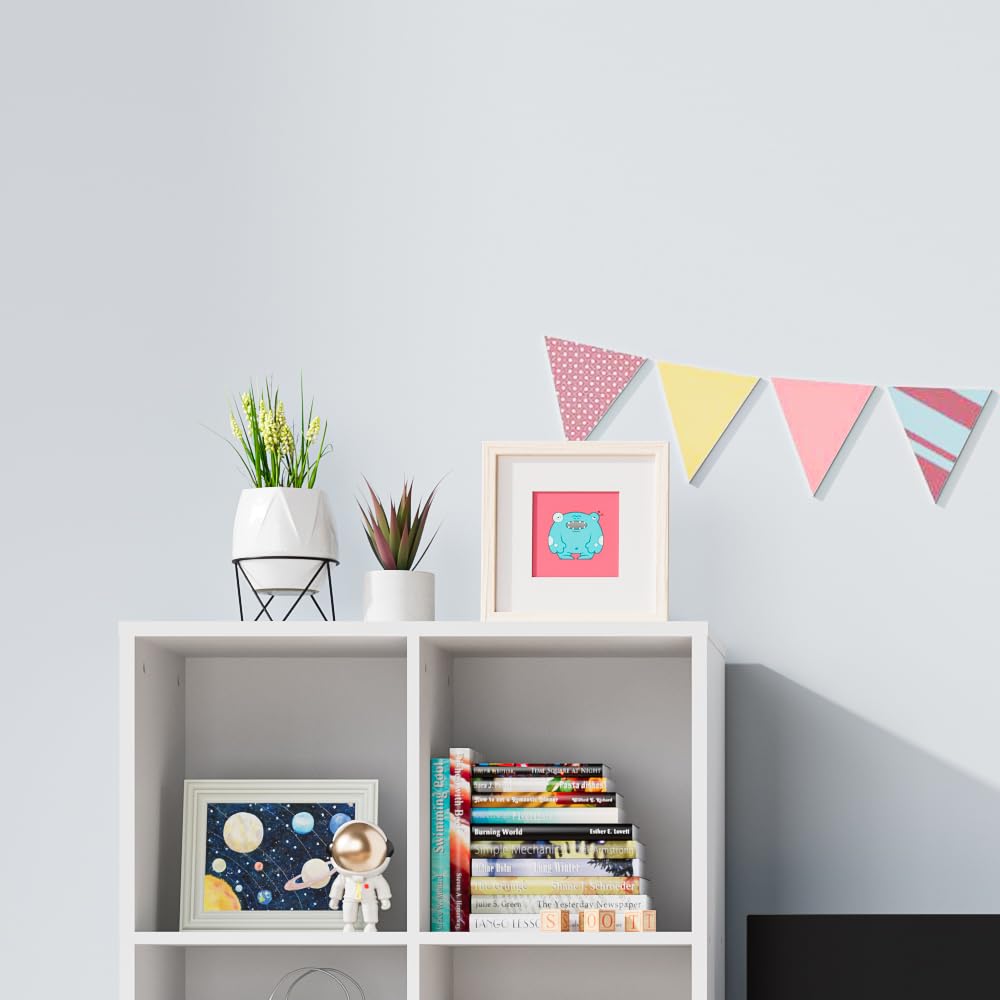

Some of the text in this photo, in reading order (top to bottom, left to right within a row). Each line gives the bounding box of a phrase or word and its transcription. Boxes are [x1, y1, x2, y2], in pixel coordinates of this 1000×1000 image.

[559, 780, 579, 789] Pasta
[455, 787, 464, 807] with
[432, 761, 448, 854] Swimming Pool
[474, 828, 523, 838] Burning World
[501, 900, 522, 908] Green
[537, 900, 642, 910] The Yesterday Newspaper
